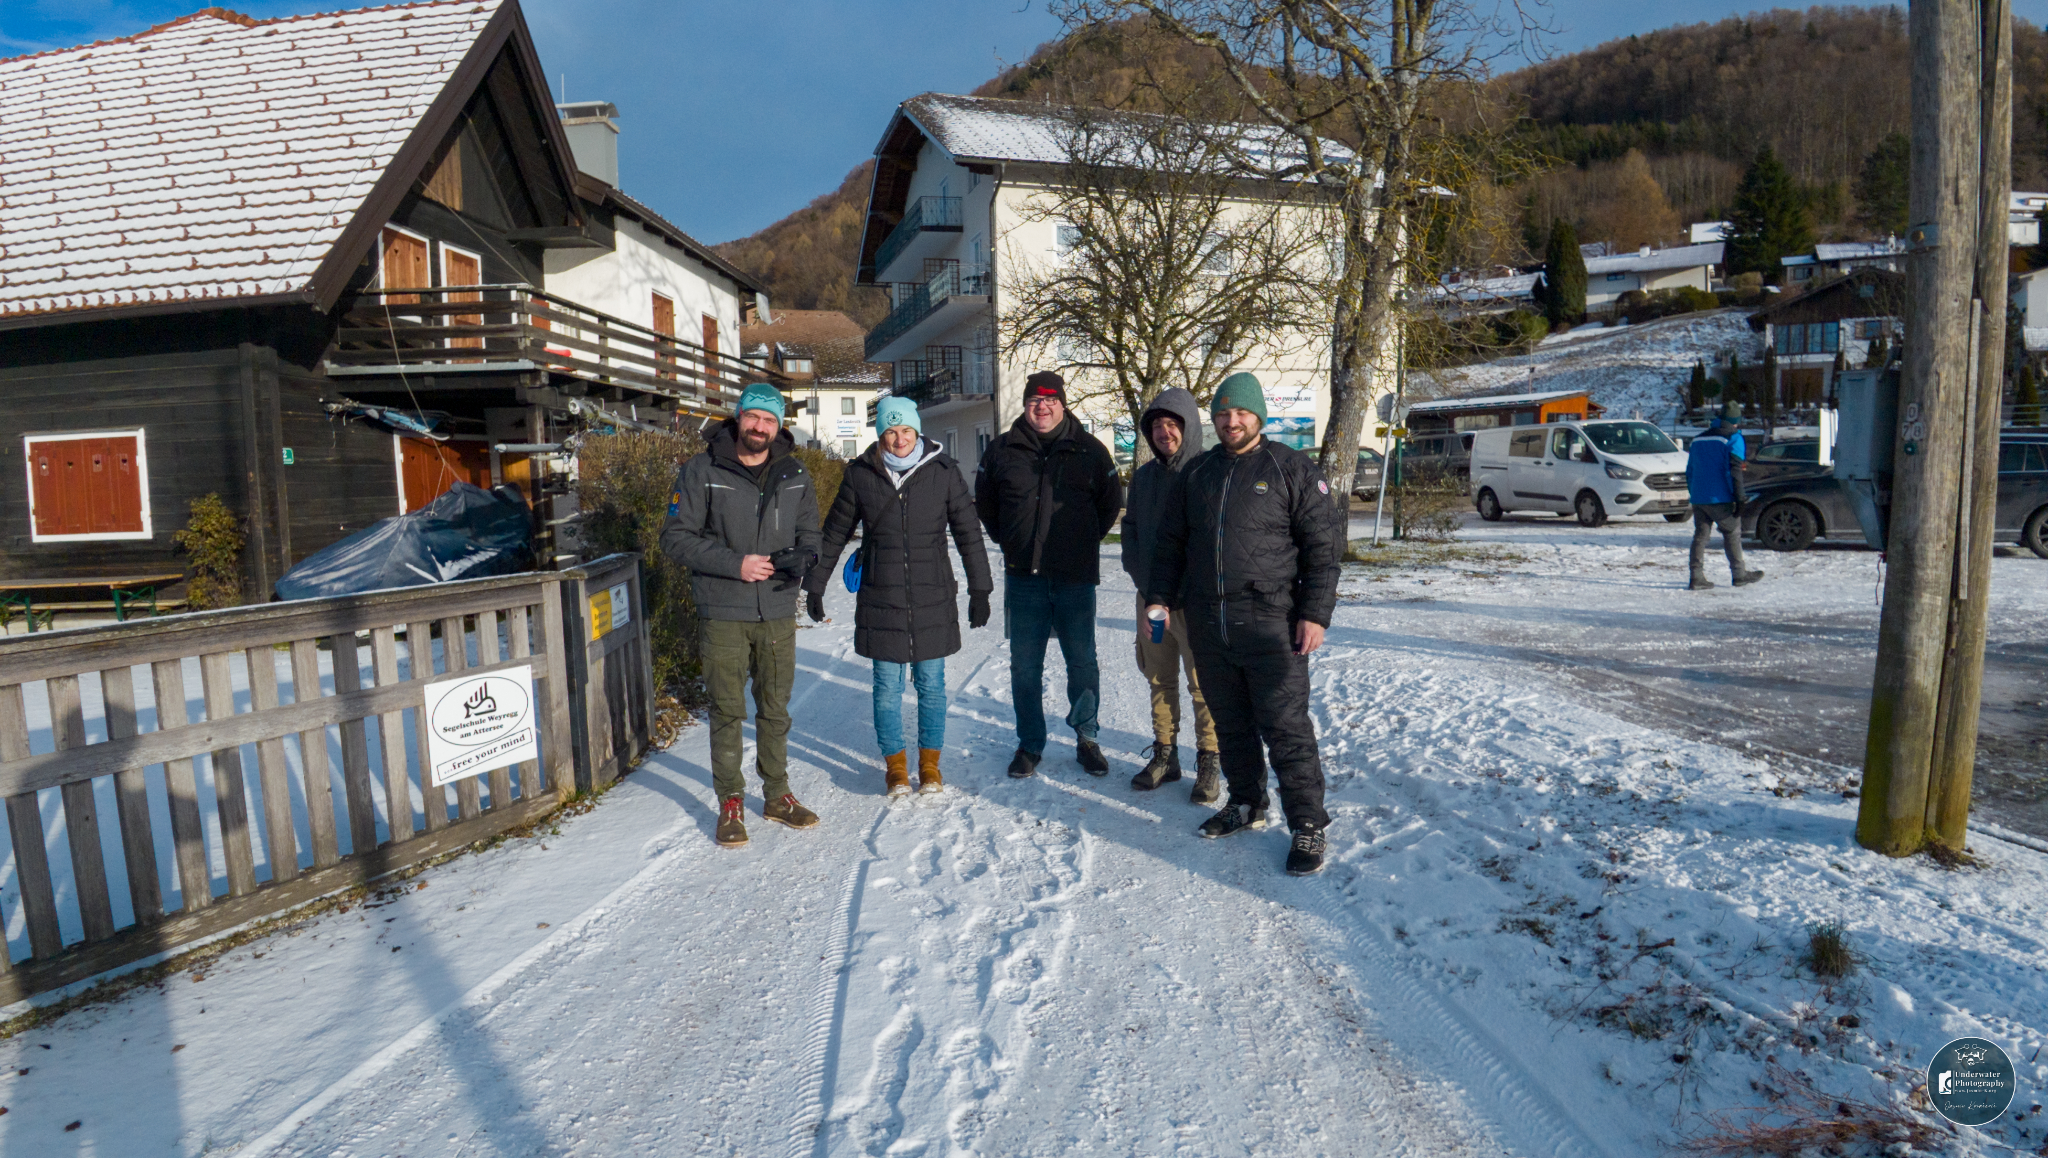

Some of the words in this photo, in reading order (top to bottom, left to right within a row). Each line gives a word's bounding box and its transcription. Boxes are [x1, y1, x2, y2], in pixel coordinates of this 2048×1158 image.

[442, 718, 486, 733] Segelschule
[488, 712, 518, 721] Weyregg
[460, 731, 472, 739] am
[473, 724, 503, 735] Attersee
[475, 745, 498, 762] your
[501, 734, 525, 749] mind
